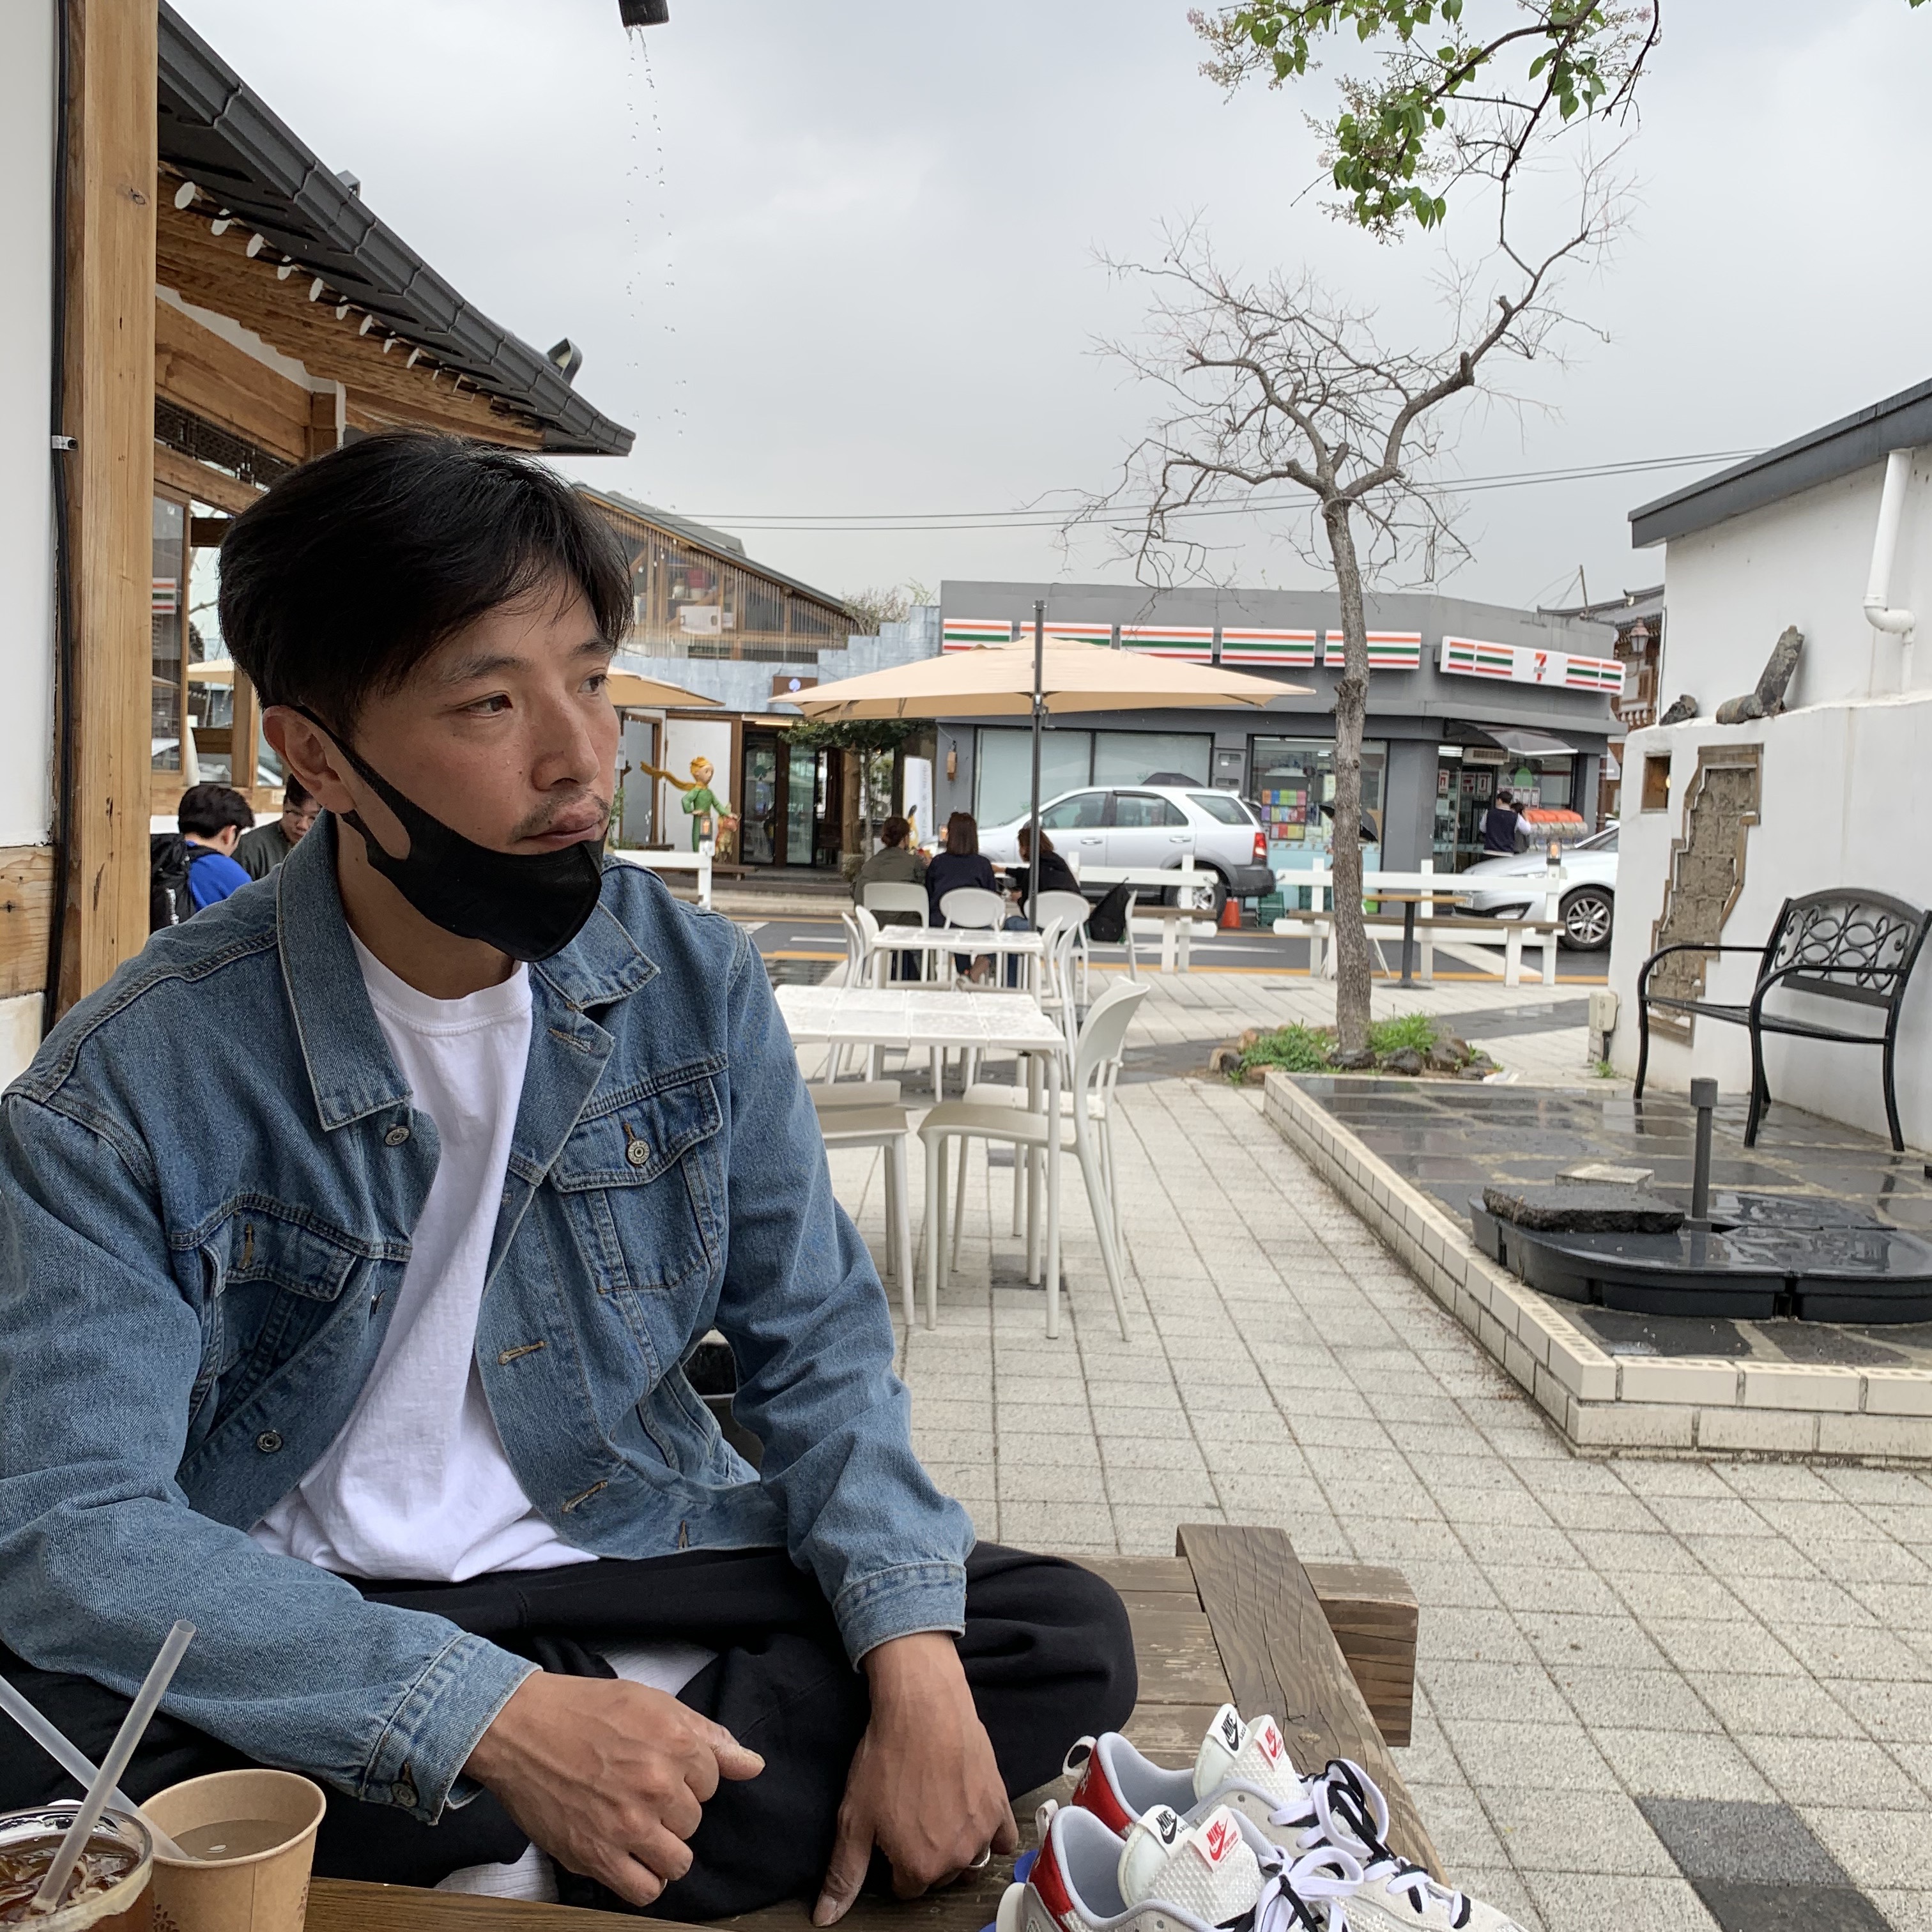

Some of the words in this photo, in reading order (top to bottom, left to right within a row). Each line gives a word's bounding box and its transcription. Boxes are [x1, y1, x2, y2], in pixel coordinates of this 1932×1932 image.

[1535, 652, 1547, 682] 7
[1221, 1713, 1236, 1740] NIKE
[1156, 1810, 1174, 1832] NIKE
[1206, 1820, 1223, 1846] NIKE
